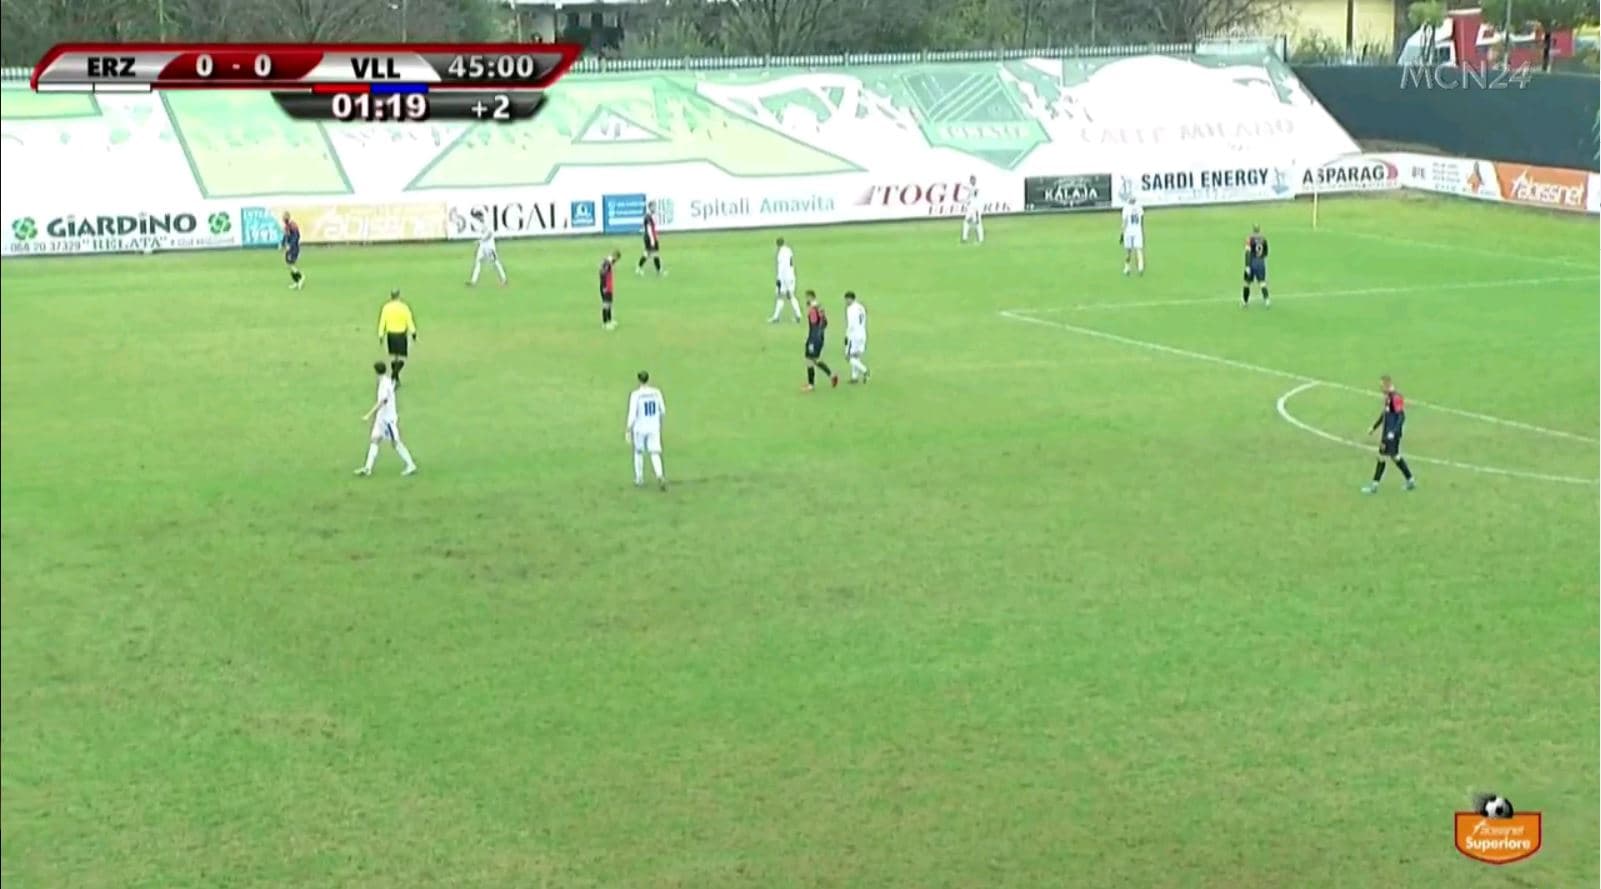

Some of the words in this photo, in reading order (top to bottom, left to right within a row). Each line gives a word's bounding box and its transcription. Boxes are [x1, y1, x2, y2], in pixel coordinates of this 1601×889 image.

[1141, 171, 1194, 191] SARDI
[1201, 168, 1269, 189] ENERGY
[690, 197, 750, 220] Spitali
[760, 195, 835, 214] Amavita
[644, 401, 656, 417] 10
